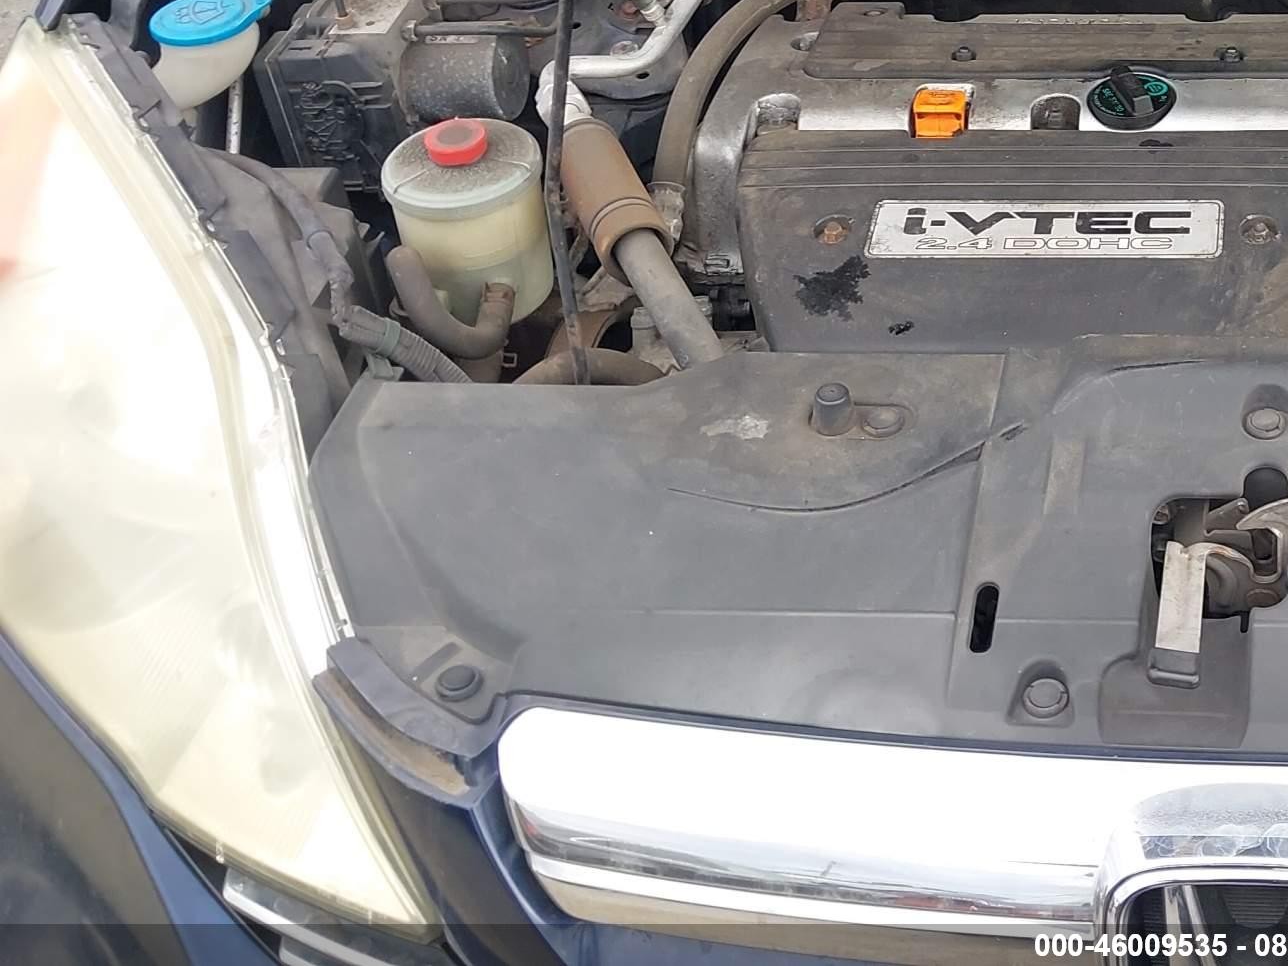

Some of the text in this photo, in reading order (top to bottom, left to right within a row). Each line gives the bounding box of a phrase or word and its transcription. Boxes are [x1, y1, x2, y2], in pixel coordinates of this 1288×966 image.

[903, 207, 1192, 235] i-VTEC
[915, 237, 1173, 250] 2.4 DOHC
